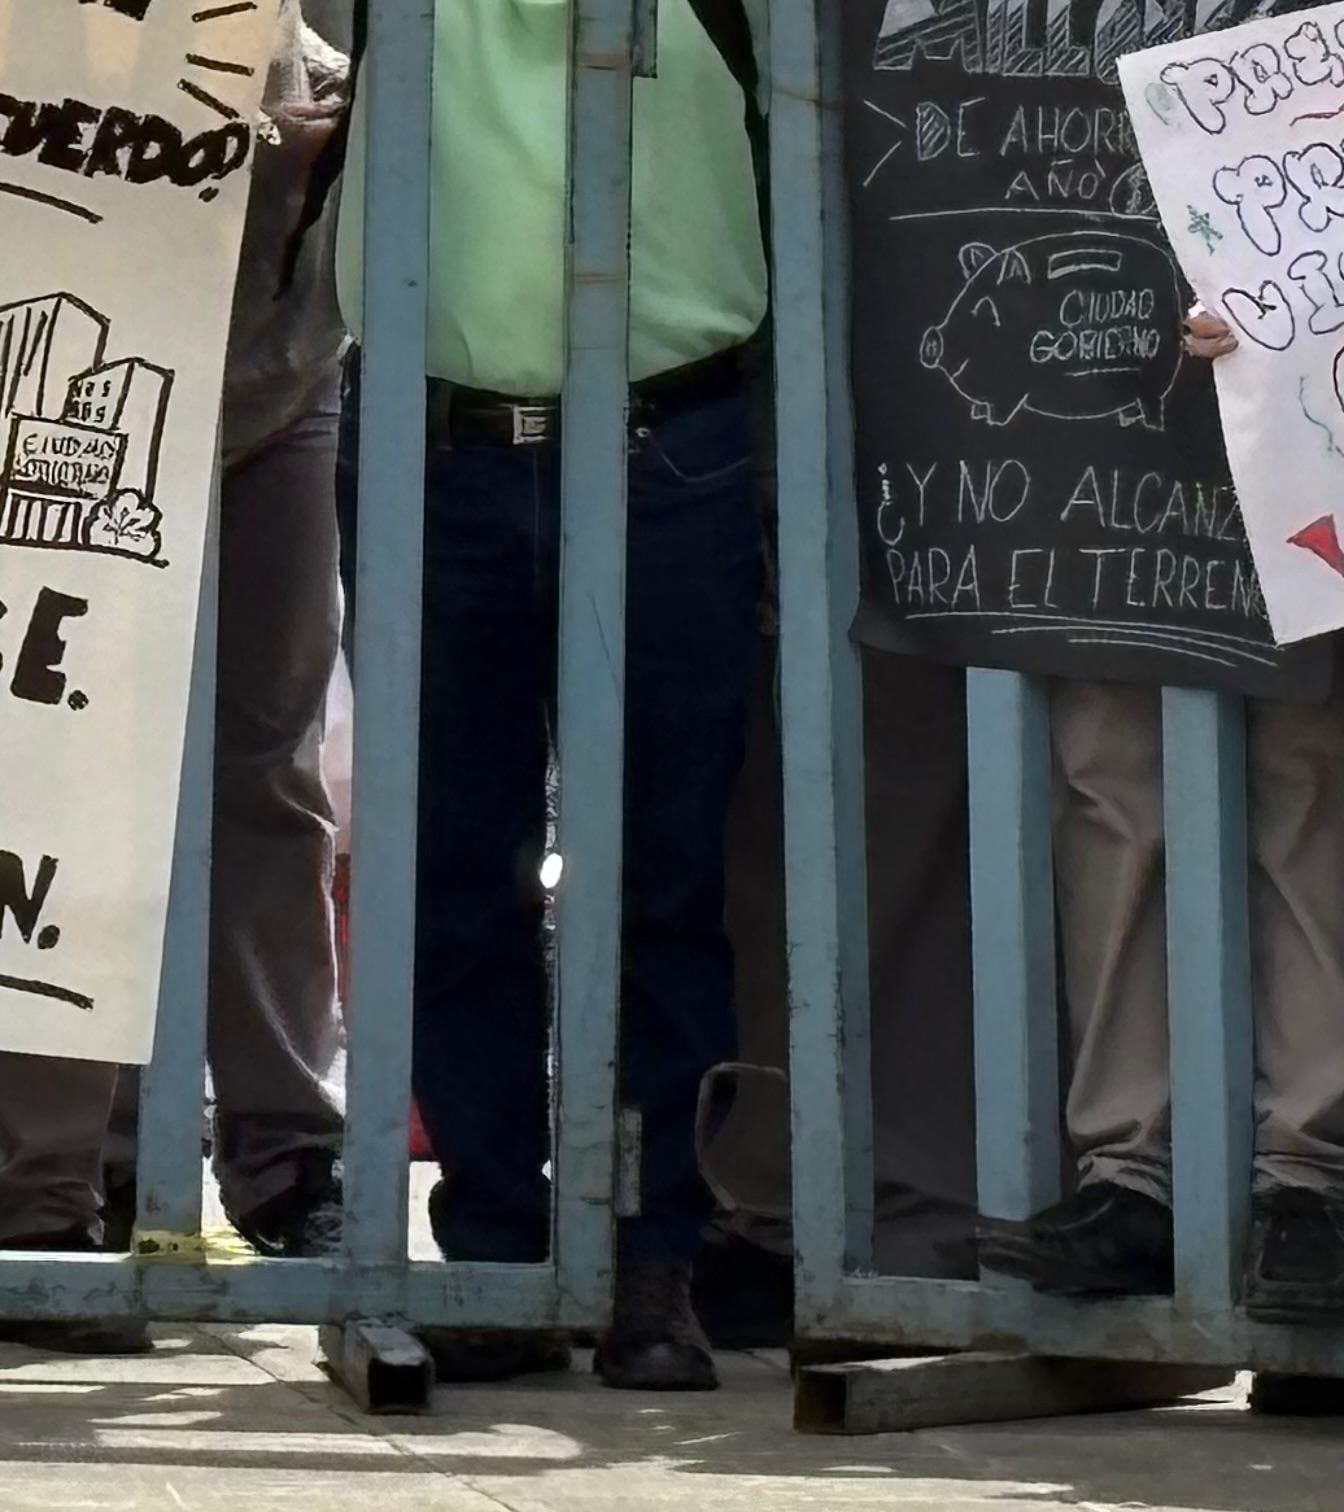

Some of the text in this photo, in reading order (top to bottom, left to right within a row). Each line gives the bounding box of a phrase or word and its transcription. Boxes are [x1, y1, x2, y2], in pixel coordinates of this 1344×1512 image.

[916, 98, 1138, 161] DE AHOR
[958, 459, 1031, 524] NO
[885, 544, 1269, 618] PARA EL TERREN
